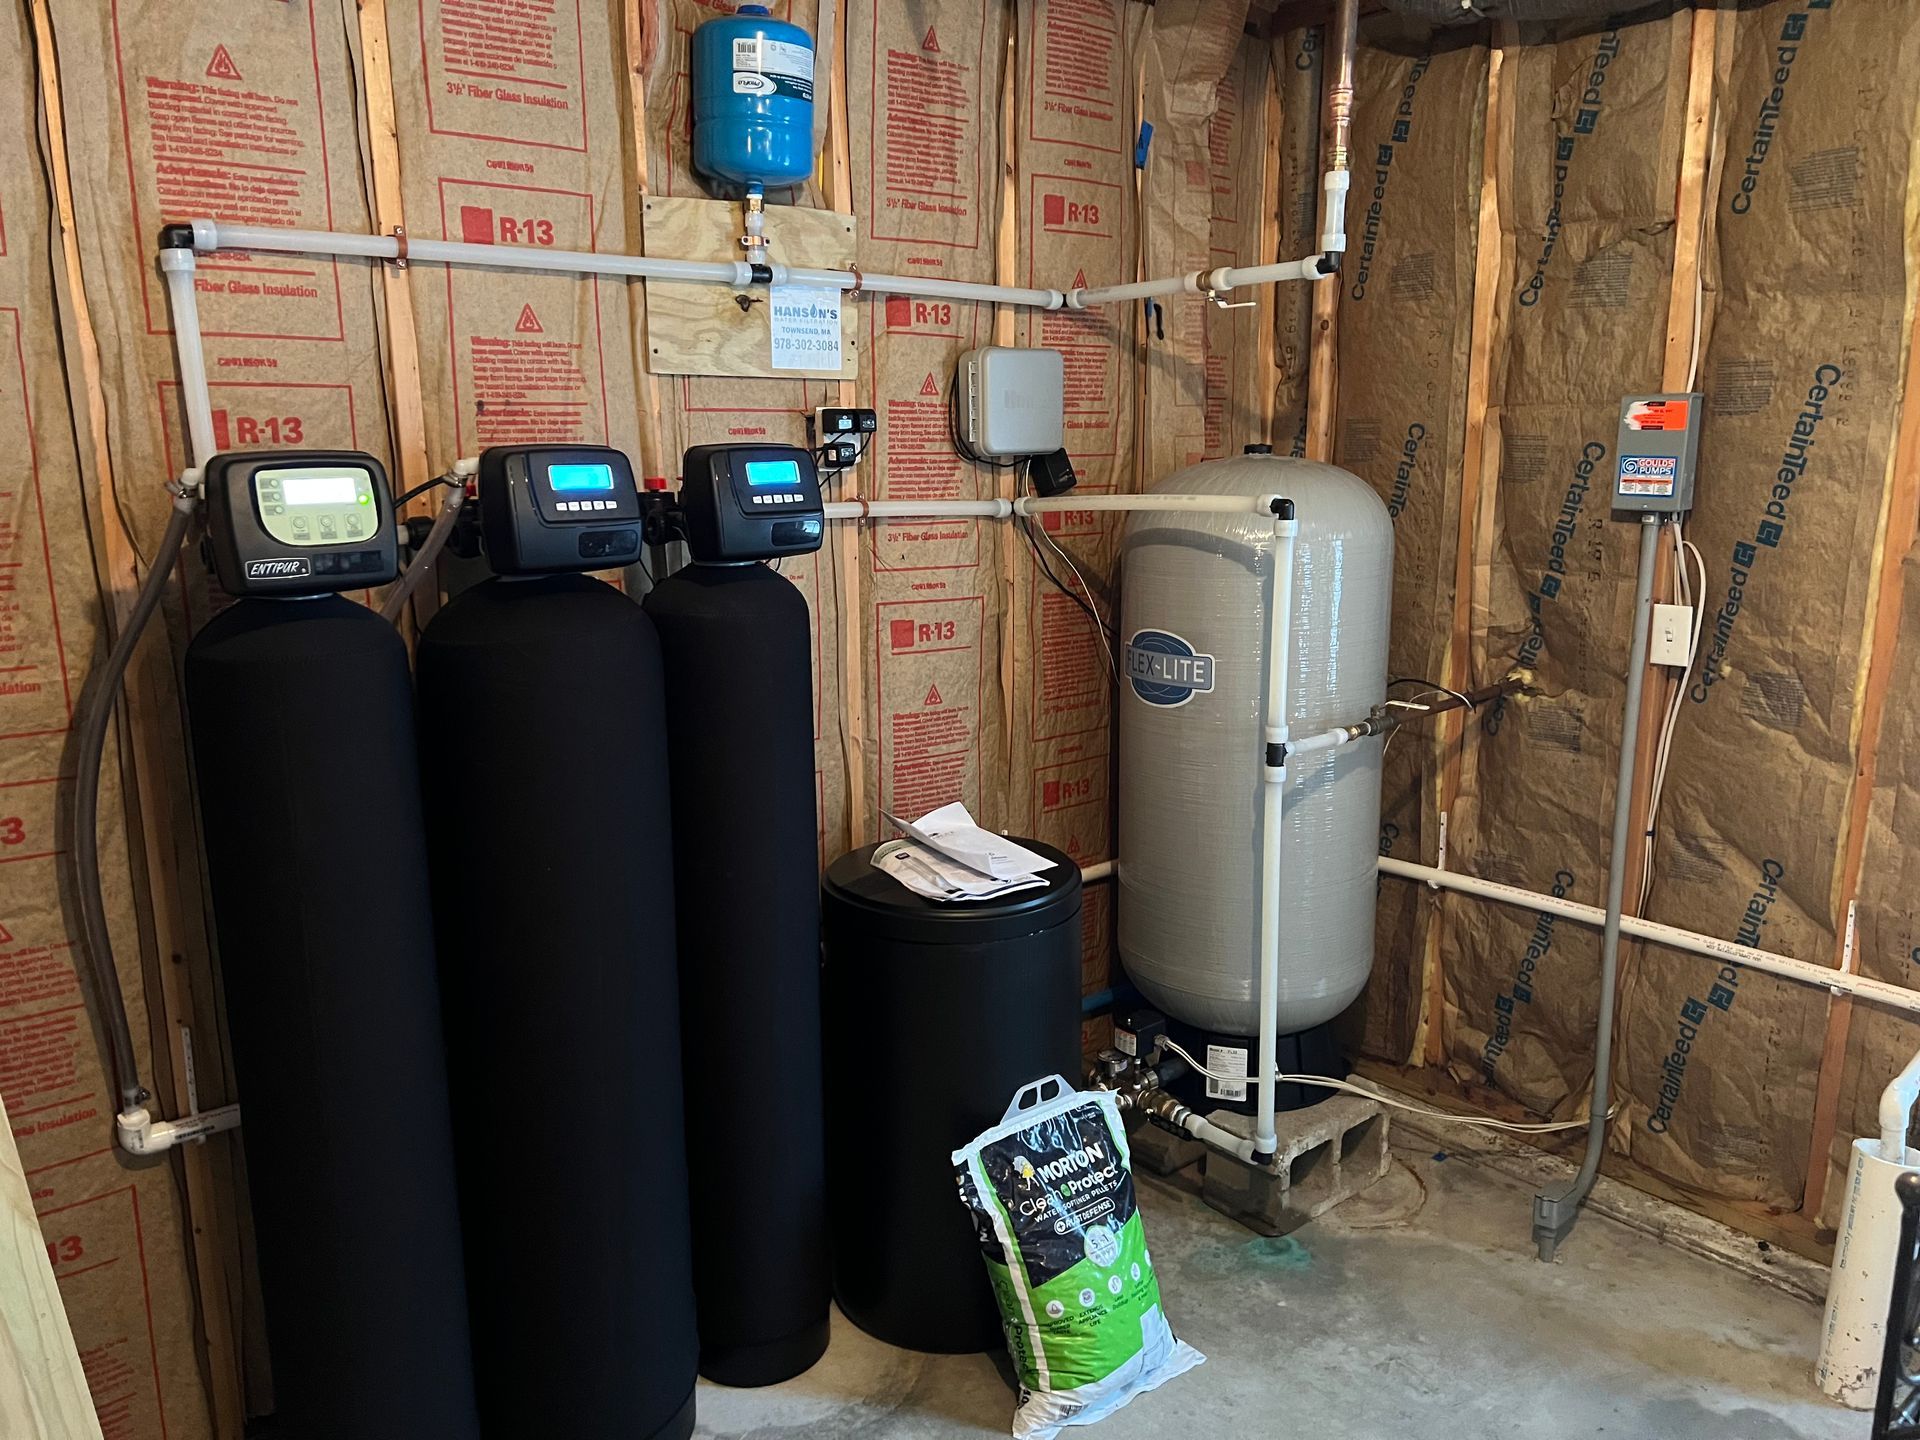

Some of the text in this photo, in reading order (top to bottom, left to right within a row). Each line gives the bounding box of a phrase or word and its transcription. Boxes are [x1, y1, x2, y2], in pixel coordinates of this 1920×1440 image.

[468, 85, 493, 98] Fiber
[496, 89, 521, 102] Glass
[524, 92, 568, 110] Insulation
[1731, 47, 1798, 215] CertainTeed
[902, 199, 916, 209] Fiber
[918, 202, 937, 212] Glass
[1068, 202, 1099, 225] R-13
[500, 217, 555, 246] R-13
[1351, 169, 1389, 301] CertainTeed
[195, 279, 317, 297] Fiber Glass Insulation
[915, 302, 951, 325] R-13
[782, 327, 819, 335] TOWNSEND,
[774, 338, 839, 352] 978-302-3084
[236, 416, 304, 444] R-13
[1764, 364, 1842, 521] CertainTeed
[1638, 458, 1675, 467] GOULDS
[1639, 467, 1672, 475] PUMPS
[1543, 440, 1606, 577] CertainTeed
[903, 532, 919, 541] Fiber
[250, 560, 300, 575] ENTIPUR
[918, 620, 955, 642] R-13
[1690, 566, 1749, 705] CertainTeed
[1127, 649, 1205, 684] FLEX-LITE
[1063, 777, 1089, 799] R-13
[1647, 1019, 1698, 1135] CertainTeed
[1037, 1142, 1104, 1183] MORTON
